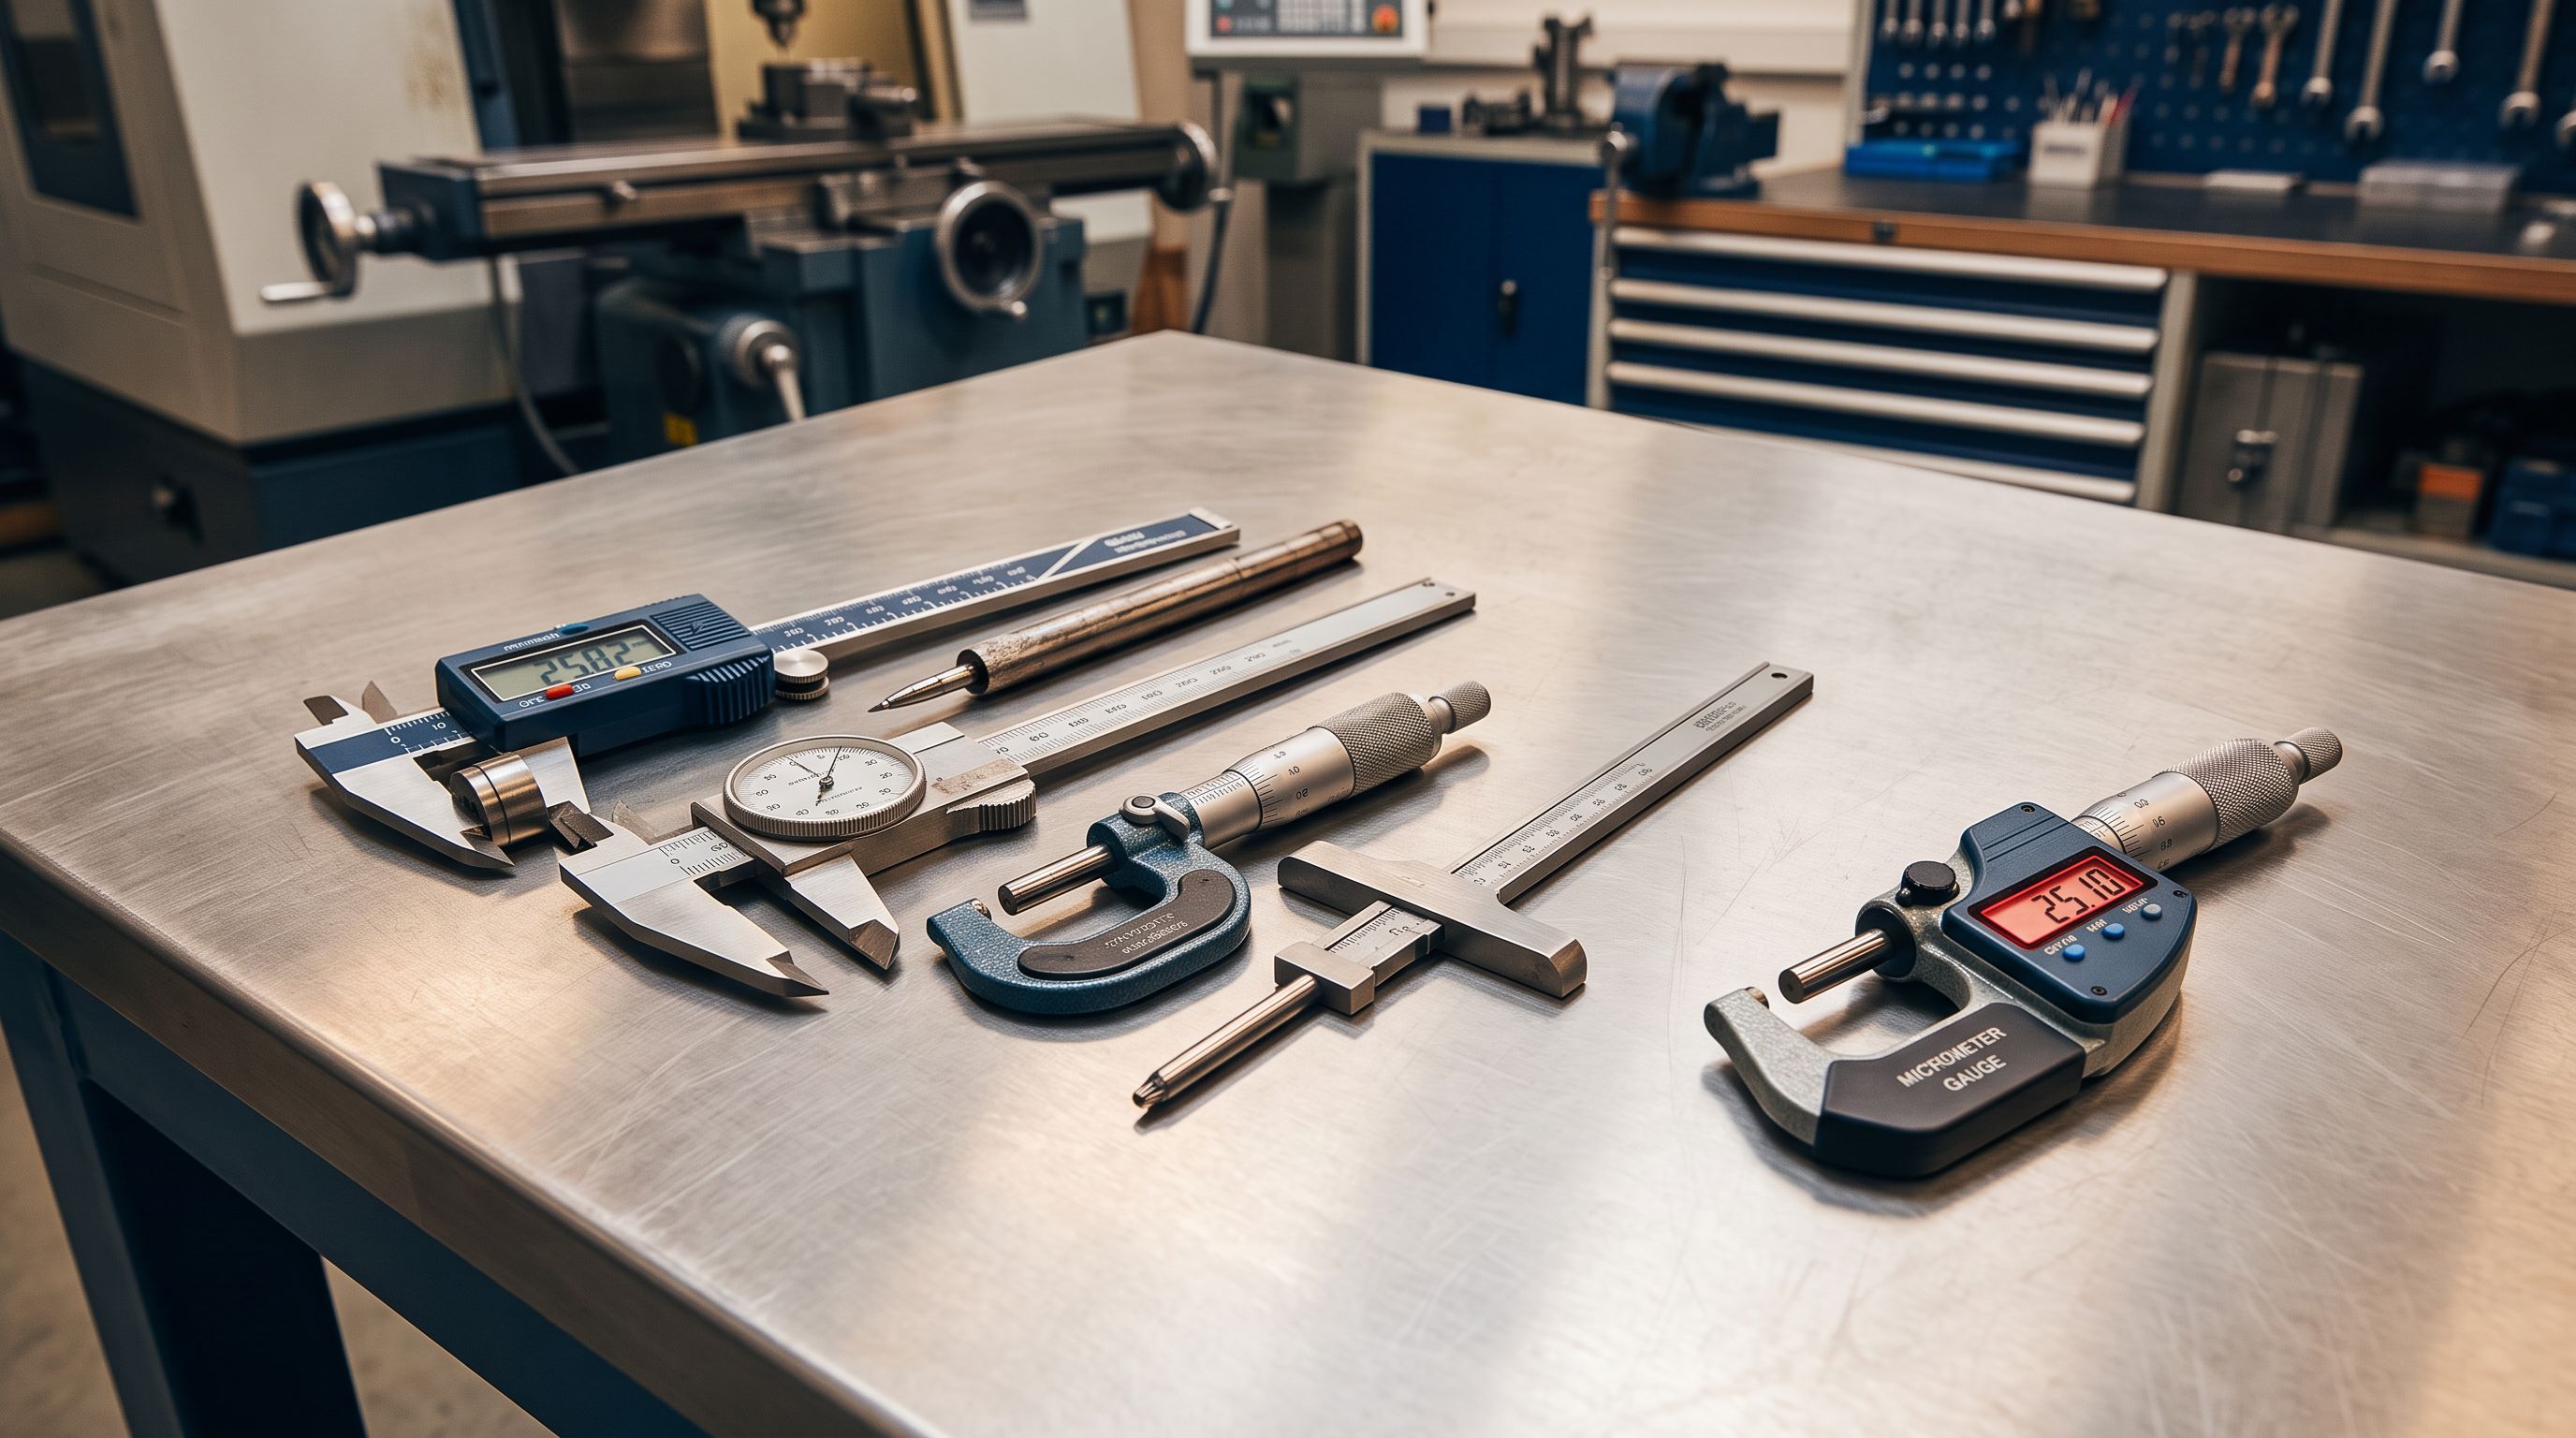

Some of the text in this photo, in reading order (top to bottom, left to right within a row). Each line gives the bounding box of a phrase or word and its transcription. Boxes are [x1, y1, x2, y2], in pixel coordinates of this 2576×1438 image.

[2030, 868, 2127, 924] 25.10
[1895, 1026, 2008, 1088] MICROMETER
[1942, 1053, 2008, 1092] GAUGE
